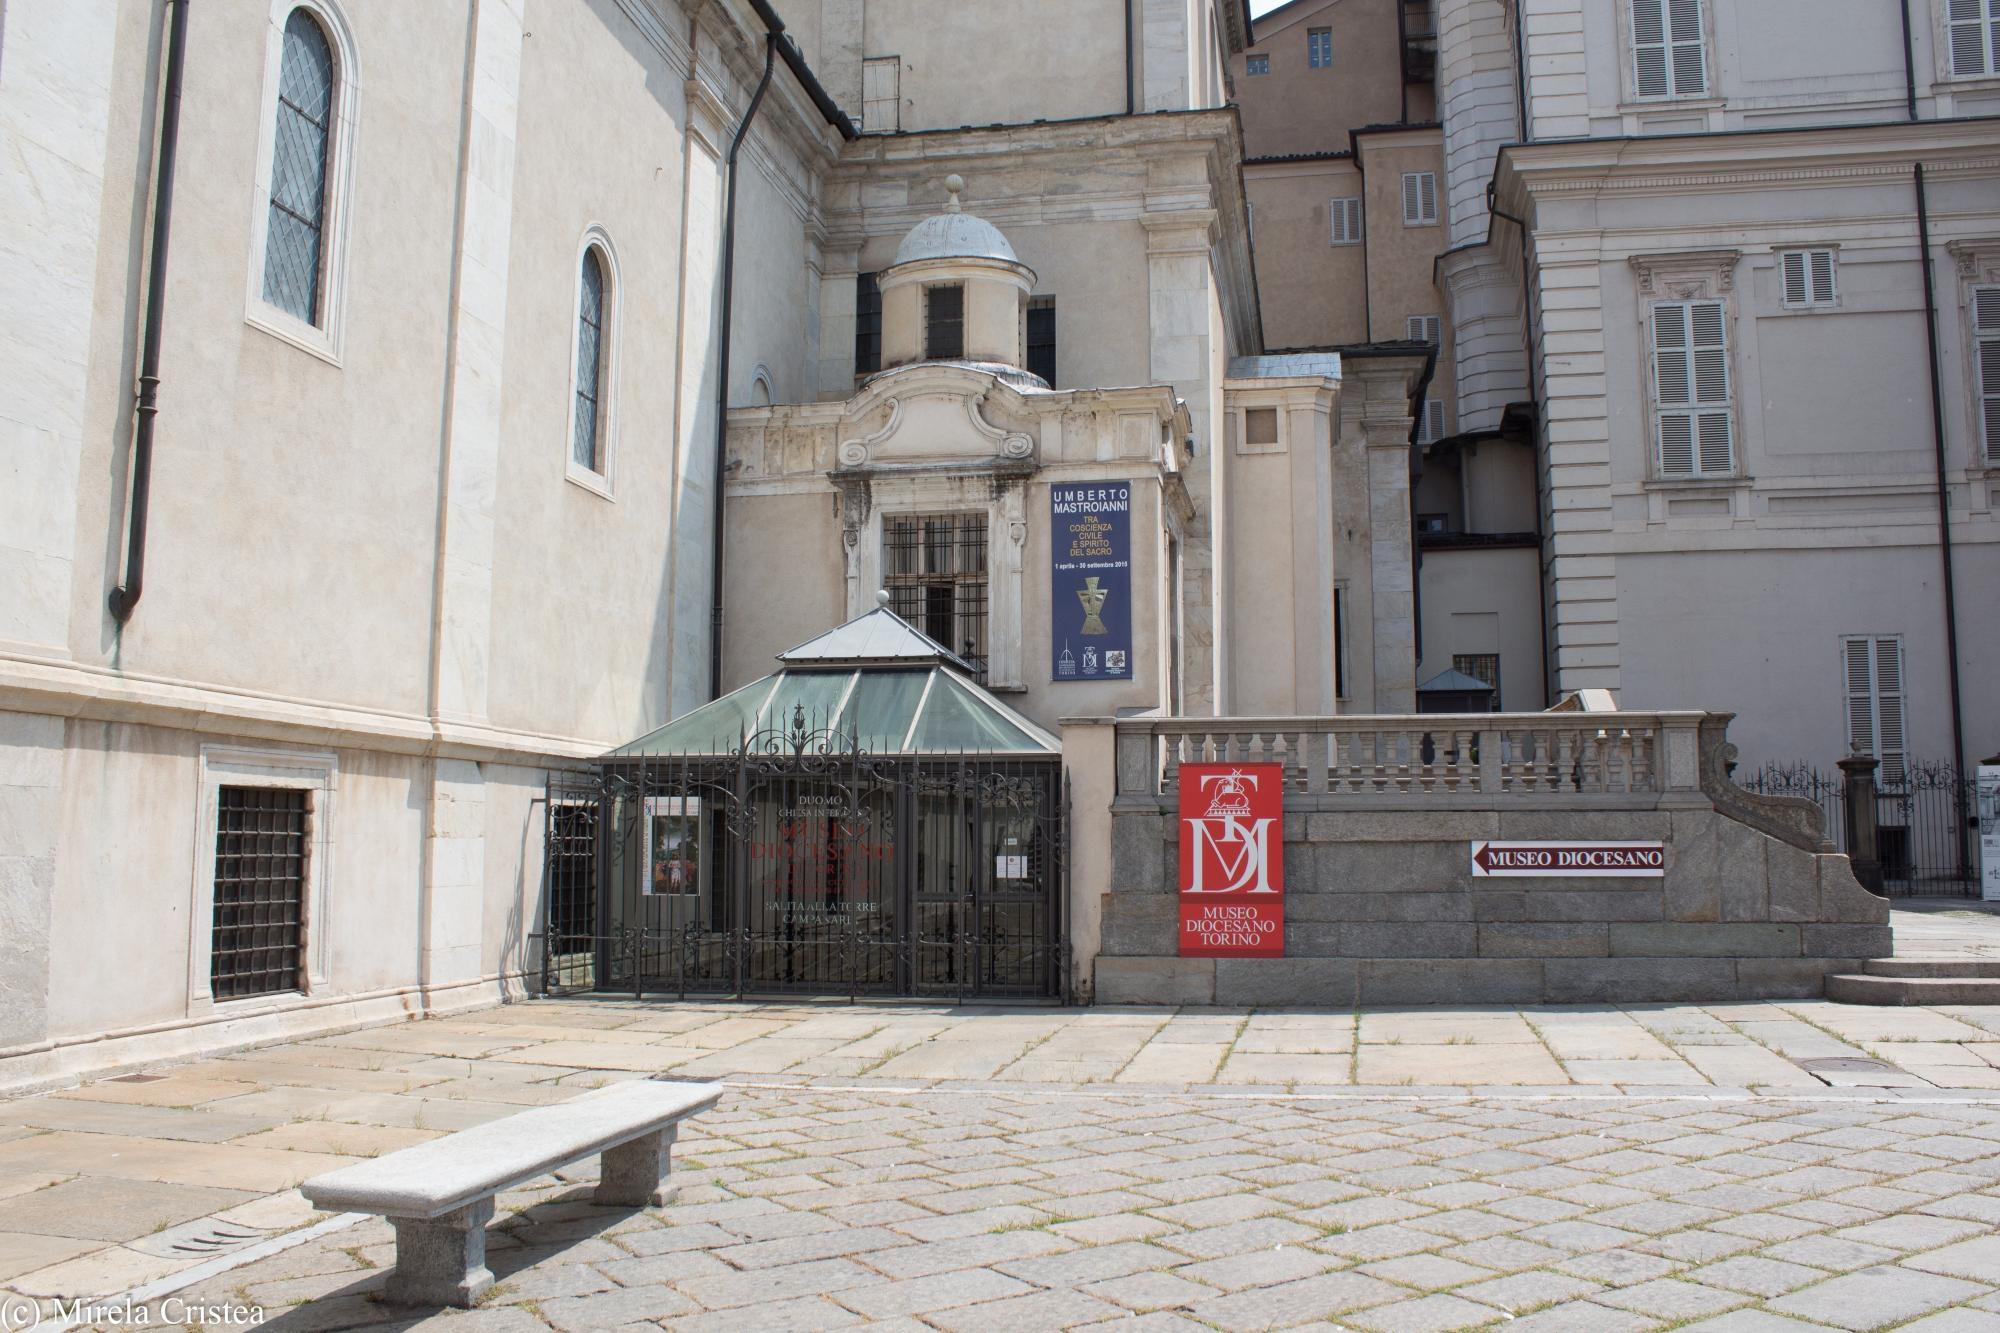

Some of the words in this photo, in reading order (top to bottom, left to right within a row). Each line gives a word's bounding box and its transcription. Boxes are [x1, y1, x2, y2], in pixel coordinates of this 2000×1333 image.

[1053, 489, 1128, 502] UMBERTO
[1054, 501, 1128, 514] MASTROIANNI
[1070, 524, 1112, 532] COSCIENZA
[1079, 532, 1103, 540] CIVILE
[1080, 540, 1109, 548] SPIRITO
[1070, 549, 1084, 557] DEL
[1086, 548, 1112, 556] SACRO
[799, 796, 843, 805] DUOMO
[1488, 851, 1552, 866] MUSEO
[1557, 851, 1663, 866] DIOCESANO
[1204, 906, 1258, 919] MUSEO
[1186, 920, 1276, 933] DIOCESANO
[1201, 933, 1261, 946] TORINO
